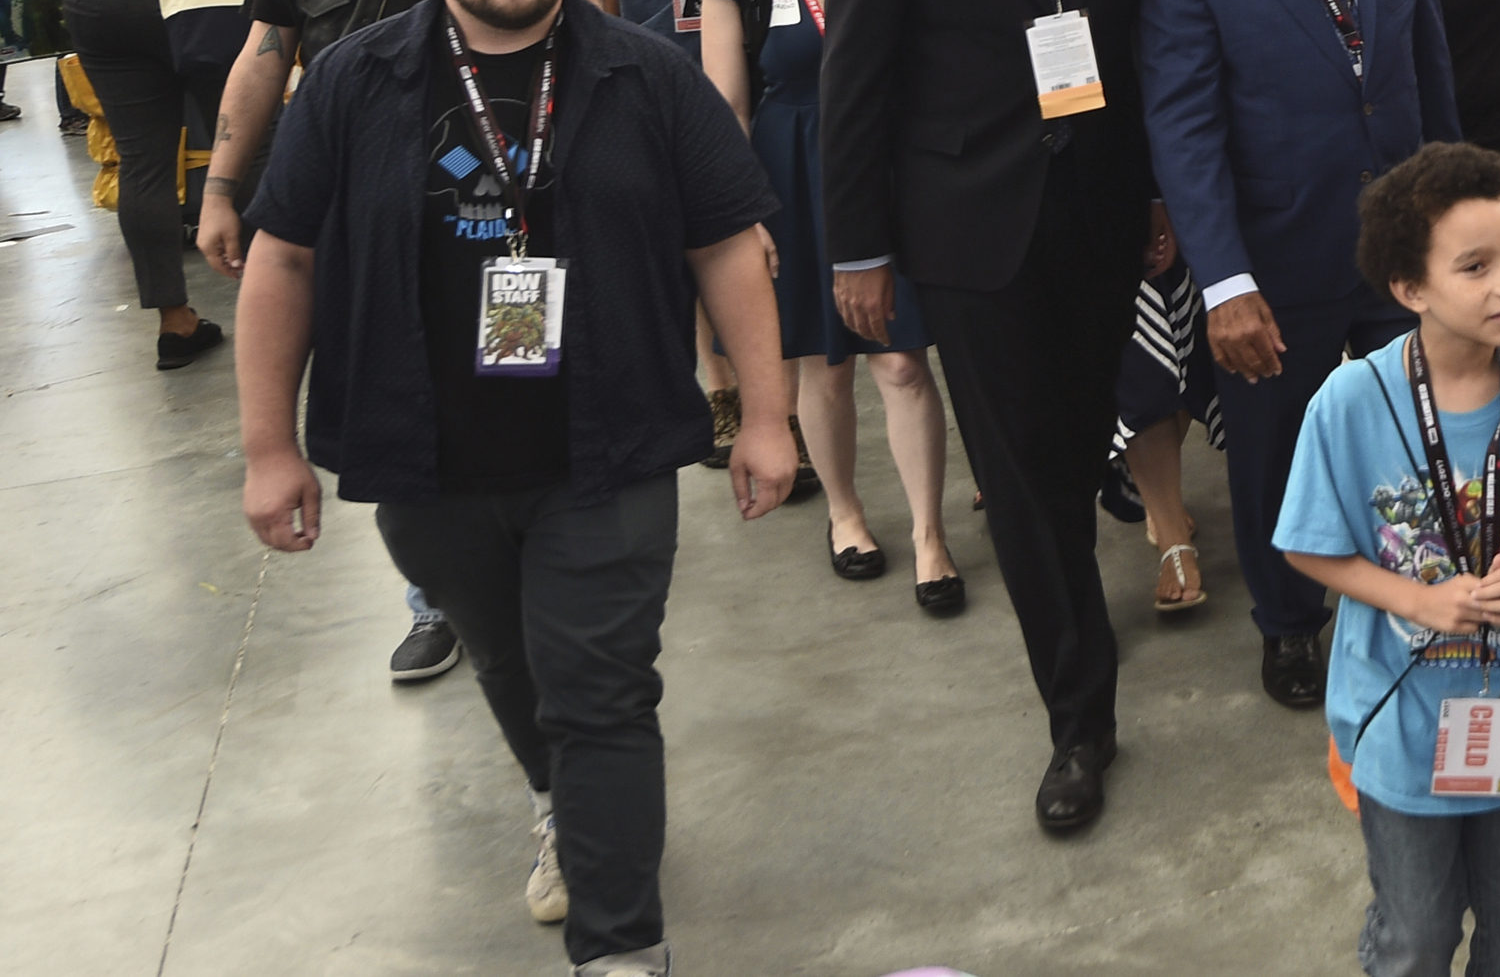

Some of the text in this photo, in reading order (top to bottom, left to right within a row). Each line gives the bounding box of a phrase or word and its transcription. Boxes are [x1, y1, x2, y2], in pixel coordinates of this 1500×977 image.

[455, 218, 508, 241] PLAID
[491, 273, 542, 291] IDW
[491, 290, 541, 304] STAFF
[1465, 705, 1495, 768] CHILD
